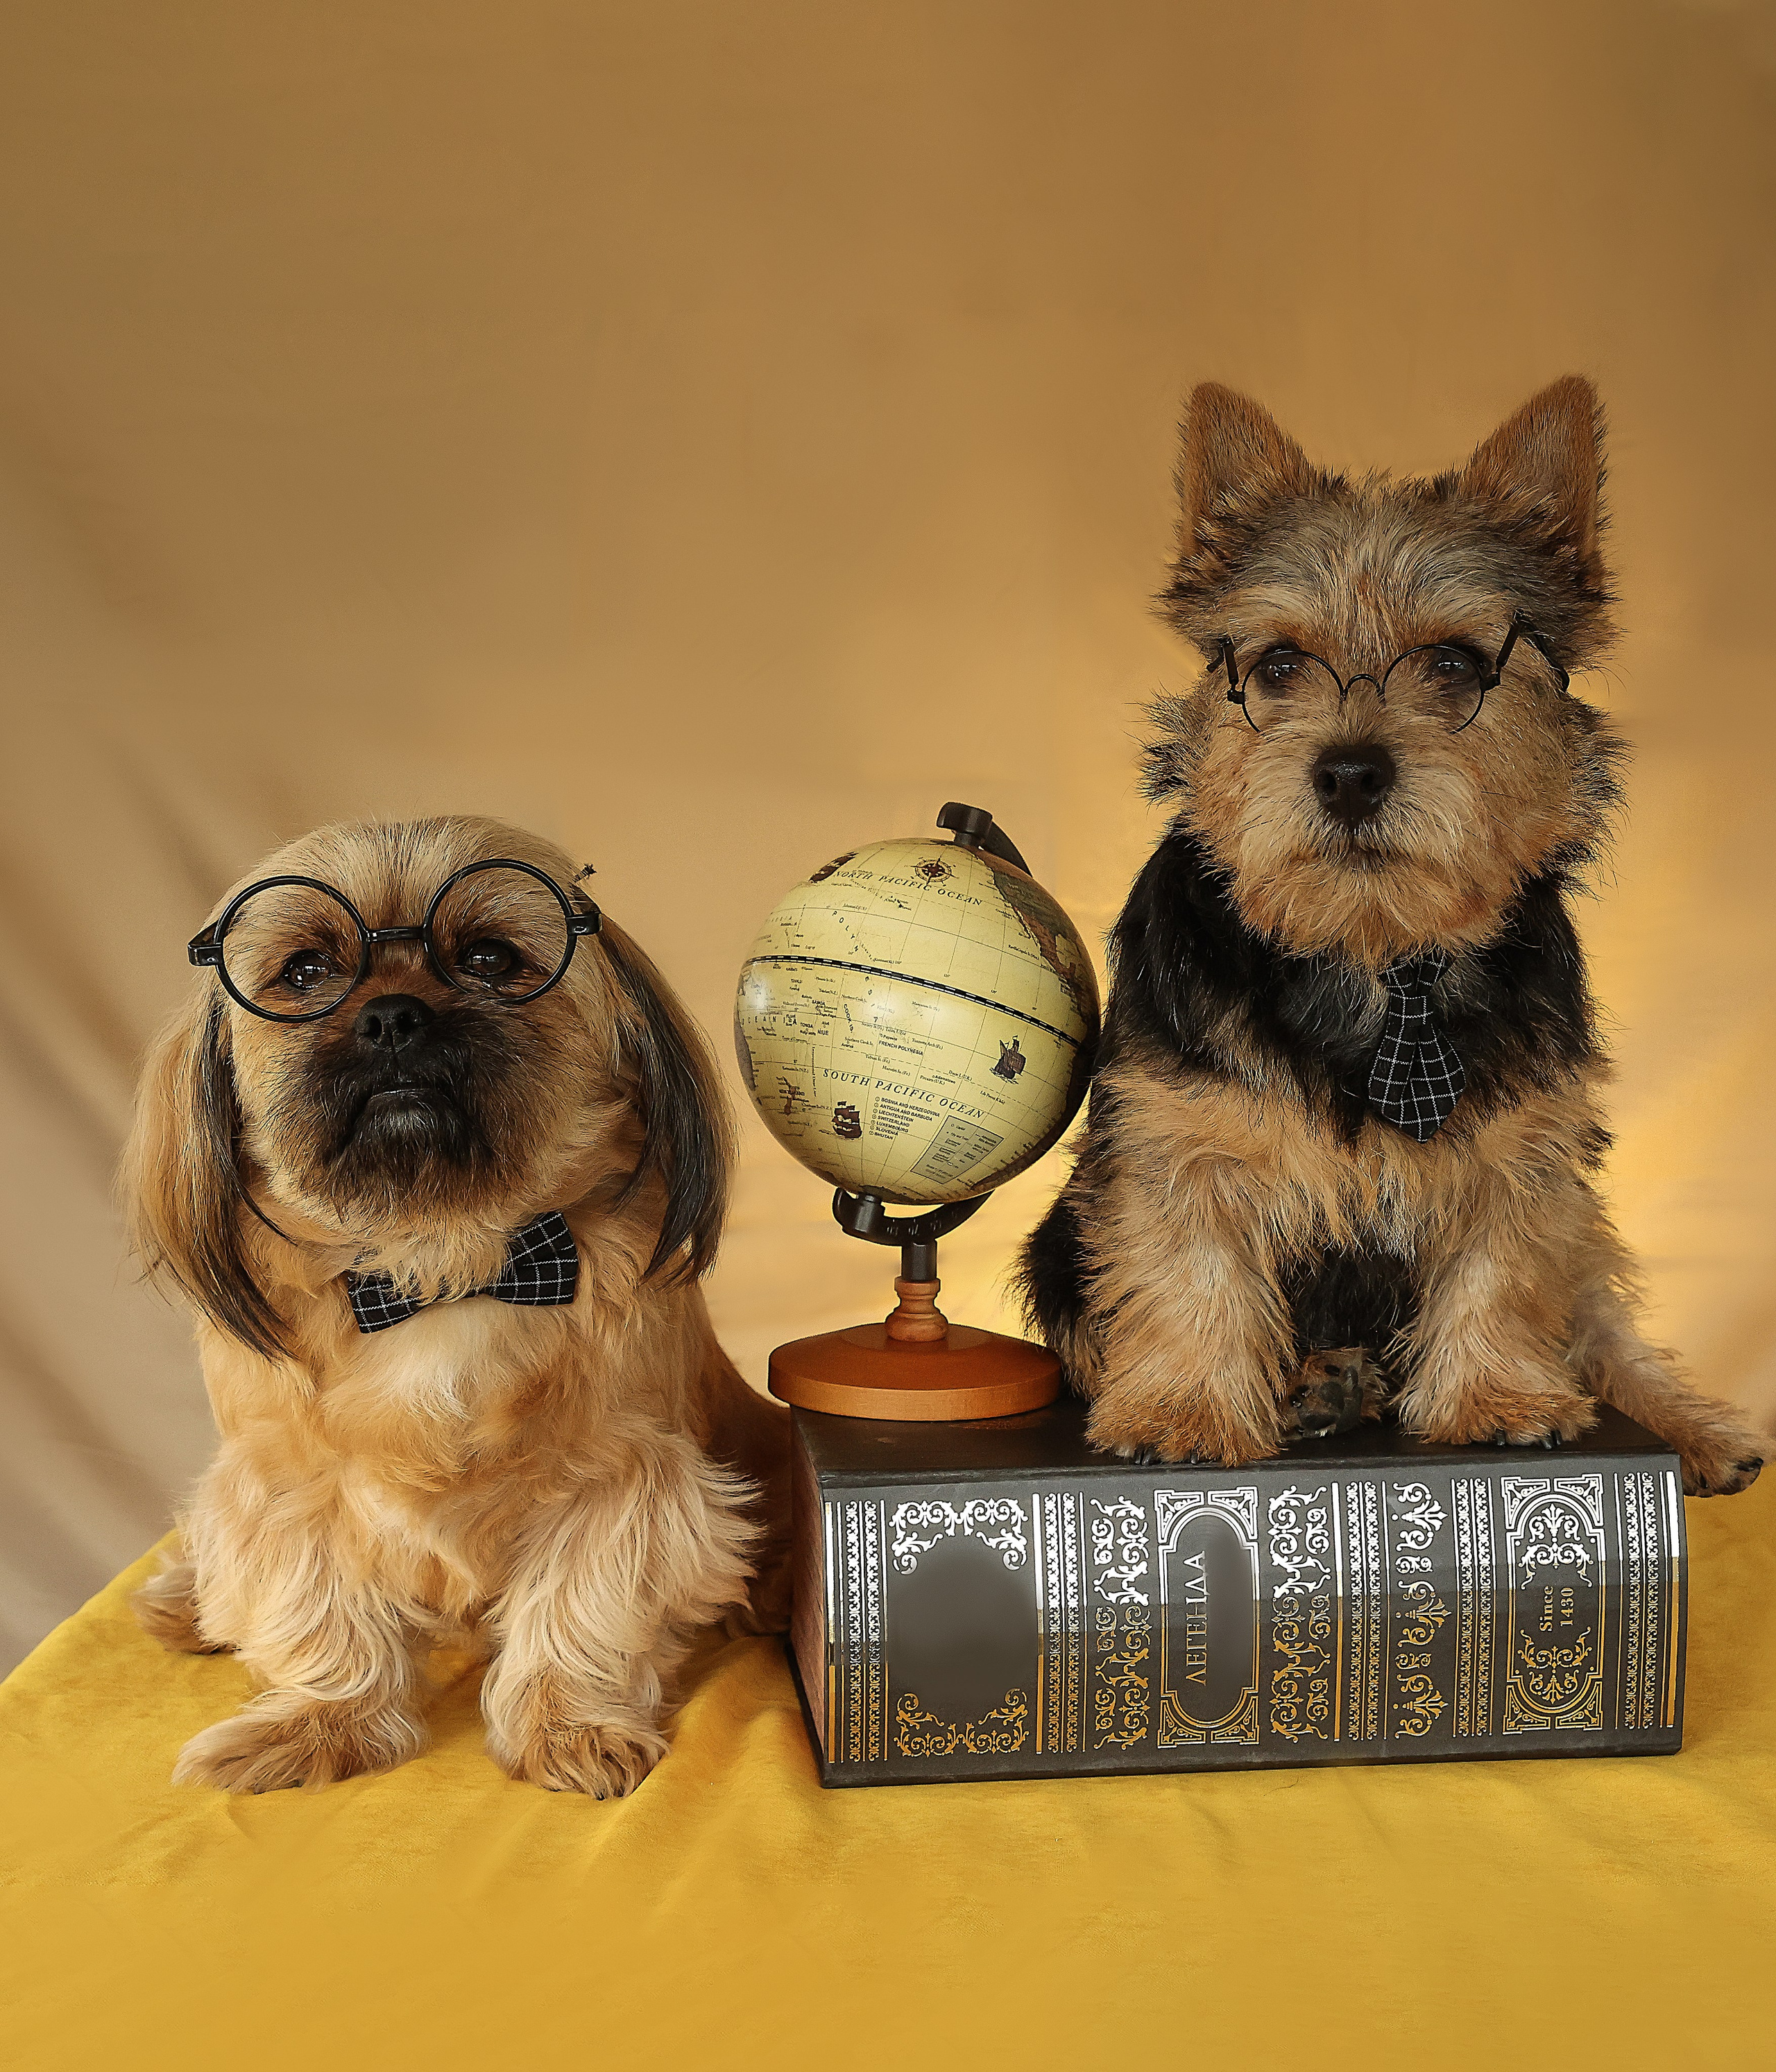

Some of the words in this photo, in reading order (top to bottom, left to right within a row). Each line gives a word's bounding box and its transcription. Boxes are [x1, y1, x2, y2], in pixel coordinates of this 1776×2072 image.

[878, 875, 932, 891] PACIFIC
[937, 889, 983, 906] OCEAN
[844, 1004, 852, 1024] COOK
[879, 1041, 898, 1049] FRENCH
[898, 1045, 923, 1056] POLYNESIA
[823, 1069, 871, 1086] SOUTH
[875, 1080, 935, 1102] PACIFIC
[939, 1098, 985, 1118] OCEAN
[878, 1110, 914, 1122] LIECHTENSTEIN
[880, 1104, 899, 1113] ANTIGUA
[910, 1111, 932, 1121] BARBUDA
[881, 1097, 898, 1106] BOSNIA
[909, 1104, 940, 1118] HERZEGOVINA
[876, 1121, 909, 1133] LUXEMBOURG
[877, 1115, 910, 1127] SWITZERLAND
[874, 1131, 894, 1140] BHUTAN
[876, 1127, 898, 1136] SLOVENIA
[1539, 1585, 1553, 1632] Since
[1560, 1587, 1574, 1627] 1430
[1184, 1550, 1211, 1686] ЛЕГЕНДА
